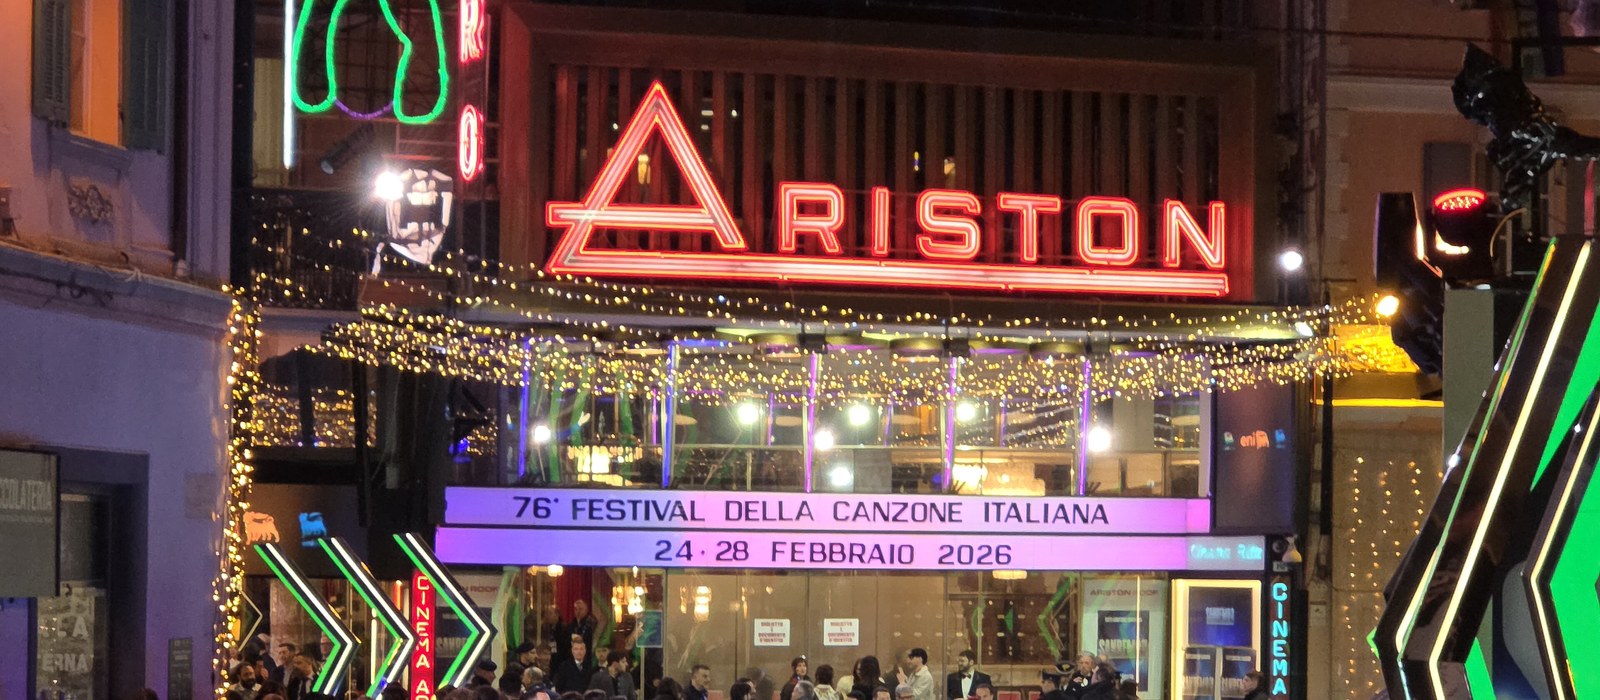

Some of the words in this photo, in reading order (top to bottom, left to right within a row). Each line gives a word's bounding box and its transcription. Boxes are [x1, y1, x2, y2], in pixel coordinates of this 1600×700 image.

[546, 80, 1228, 296] ARISTON
[571, 498, 705, 522] FESTIVAL
[725, 500, 815, 522] DELLA
[833, 501, 963, 523] CANZONE
[984, 502, 1110, 524] ITALIANA
[771, 541, 915, 566] FEBBRAIO
[938, 544, 1012, 566] 2026
[416, 575, 430, 669] CINEMA
[1272, 582, 1289, 696] CINEMA
